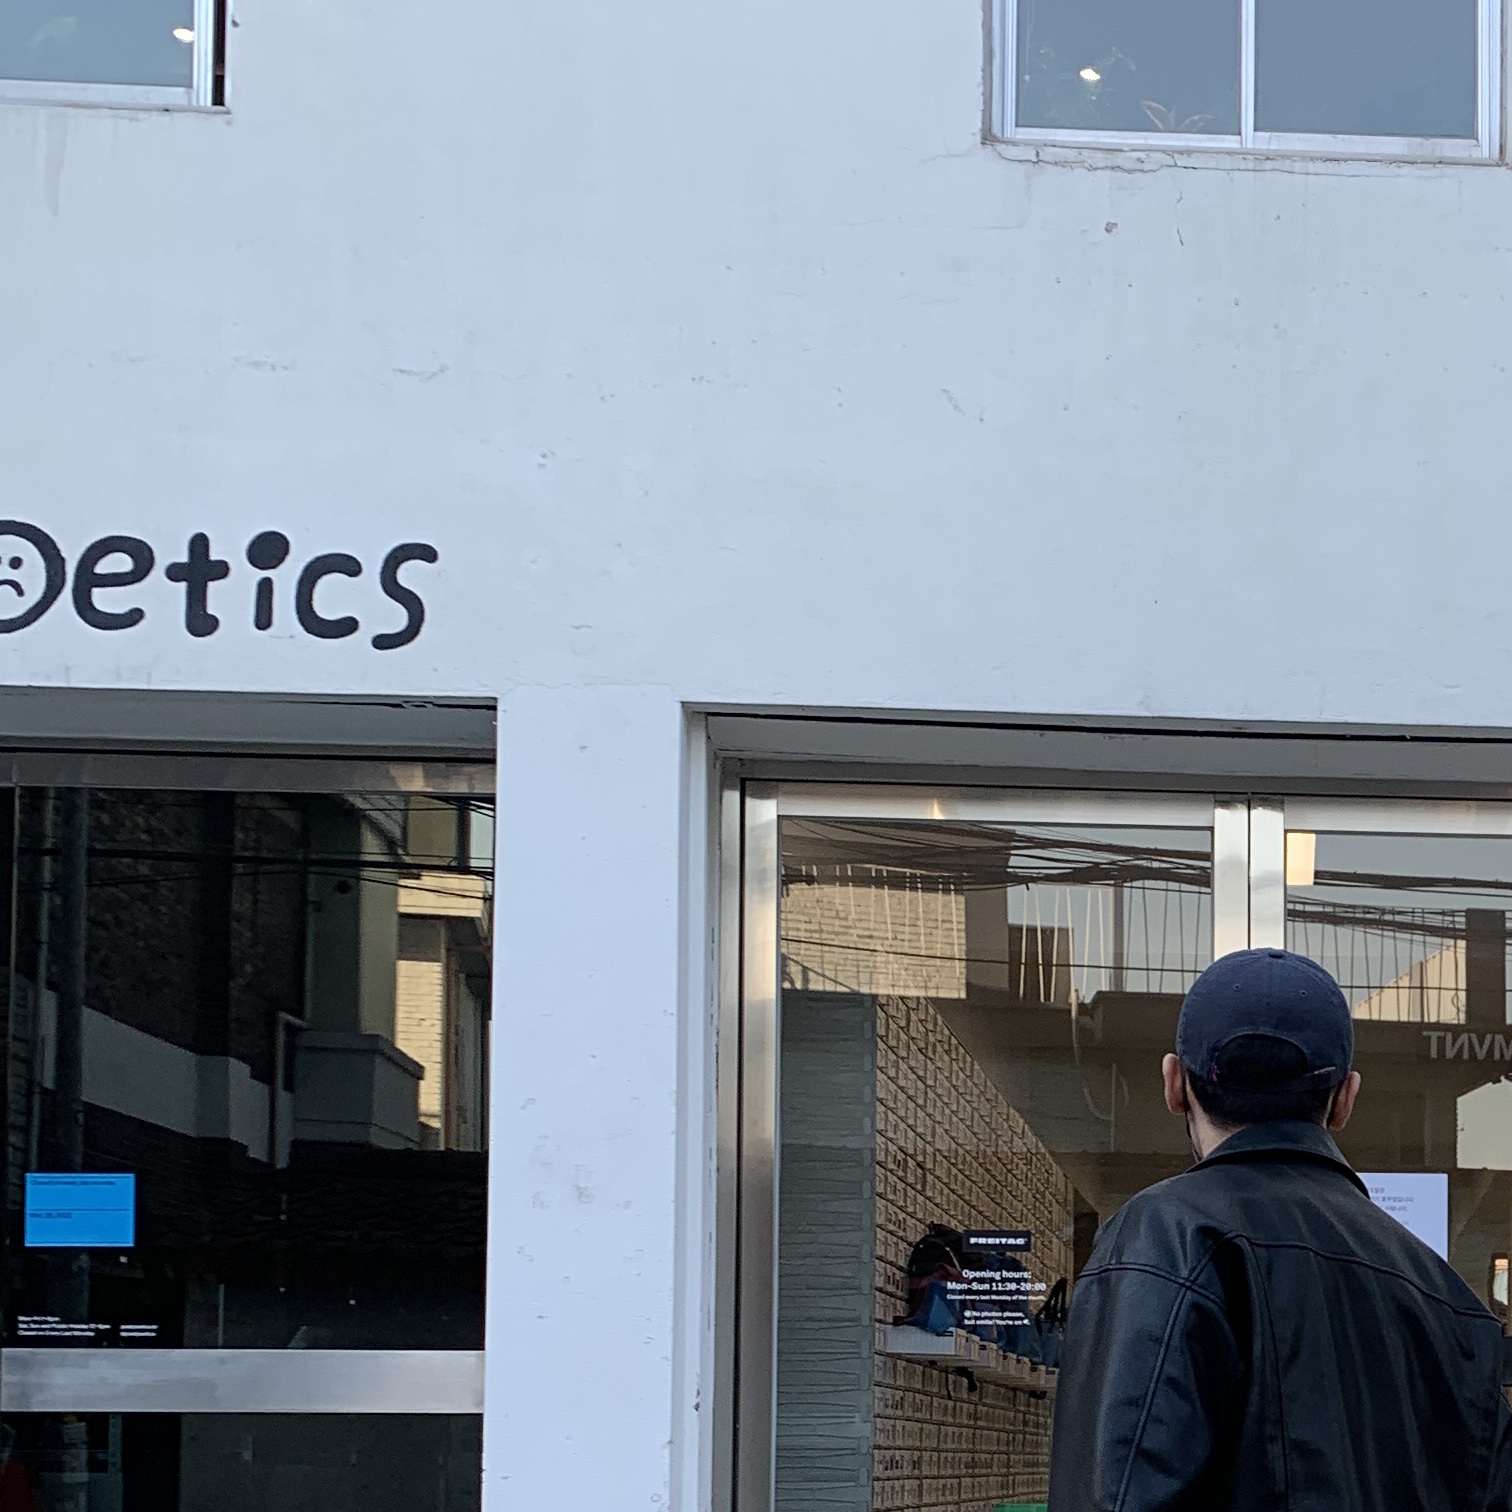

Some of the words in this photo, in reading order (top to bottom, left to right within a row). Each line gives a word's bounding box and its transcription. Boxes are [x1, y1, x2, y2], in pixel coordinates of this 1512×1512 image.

[968, 1237, 1025, 1245] FREITAG
[961, 1269, 1002, 1280] Opening
[1002, 1269, 1032, 1279] hours:
[946, 1281, 990, 1291] Mon-Sun
[991, 1282, 1047, 1291] 11:30-20:00
